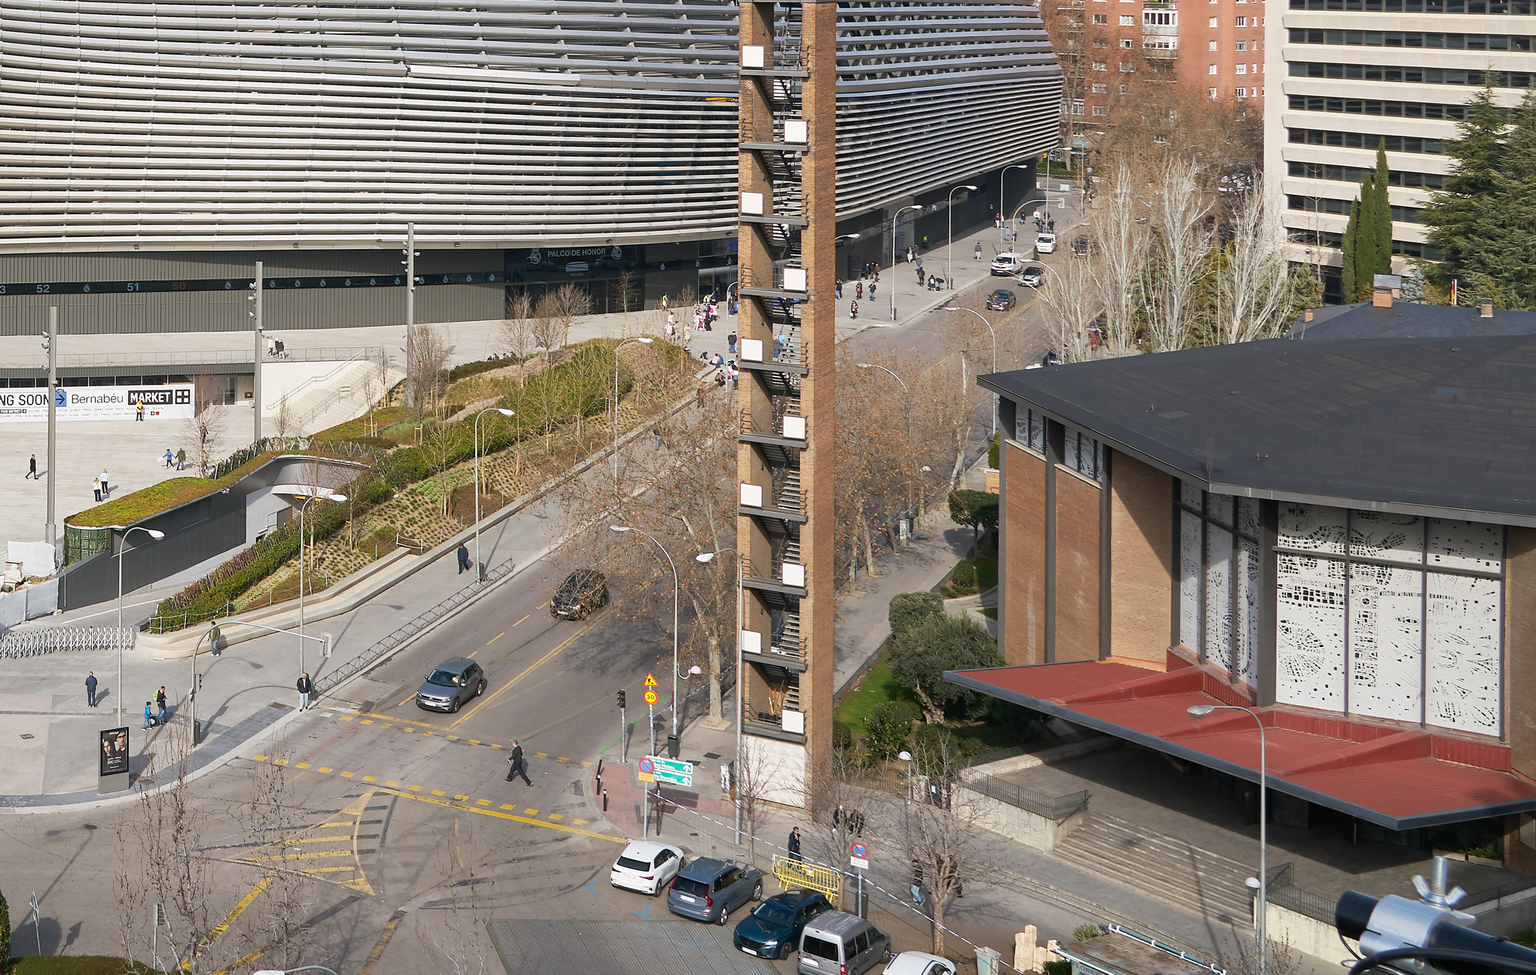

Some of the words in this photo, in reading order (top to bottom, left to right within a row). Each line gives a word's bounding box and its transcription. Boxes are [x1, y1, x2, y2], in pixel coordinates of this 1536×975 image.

[582, 248, 606, 256] HONOR
[36, 284, 50, 293] 52
[127, 283, 139, 291] 51
[172, 282, 186, 290] 50
[71, 393, 123, 404] Bernabéu
[130, 392, 171, 403] MARKET
